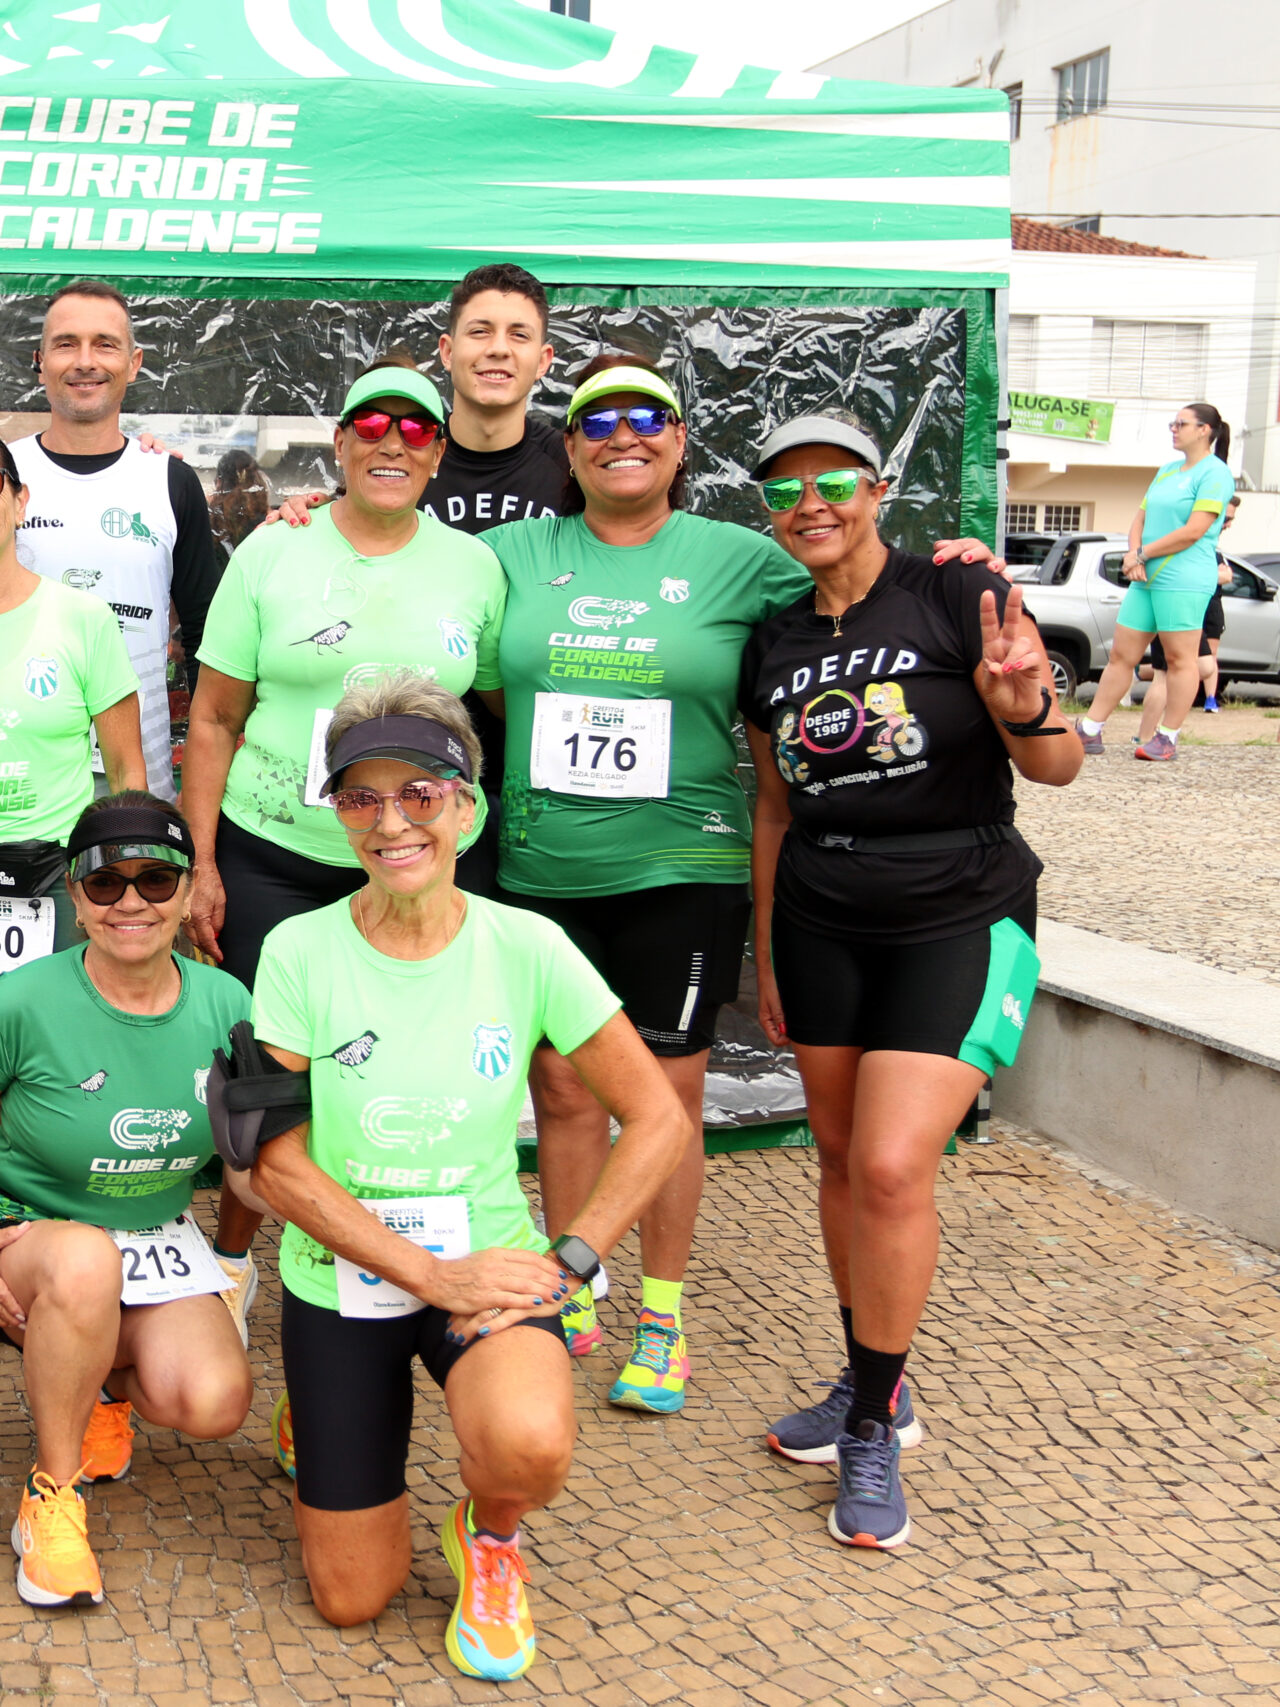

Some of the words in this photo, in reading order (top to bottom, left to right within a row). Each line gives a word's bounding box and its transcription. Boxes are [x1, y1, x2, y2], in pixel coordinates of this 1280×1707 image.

[208, 103, 300, 148] DE
[16, 516, 64, 530] olive.
[107, 602, 153, 620] RRIDA
[548, 632, 621, 650] CLUBE
[624, 637, 658, 652] DE
[549, 647, 645, 667] CORRIDA
[549, 662, 665, 684] CALDENSE
[770, 648, 917, 706] ADEFIP
[592, 711, 624, 724] RUN
[806, 708, 852, 728] DESDE
[814, 721, 848, 738] 1987
[564, 733, 637, 772] 176
[0, 761, 30, 777] DE
[886, 760, 928, 778] INCLUSÃO
[90, 1158, 166, 1173] CLUBE
[168, 1156, 198, 1170] DE
[345, 1158, 432, 1188] CLUBE
[88, 1171, 185, 1185] CORRIDA
[384, 1216, 424, 1229] RUN
[121, 1244, 191, 1281] 213
